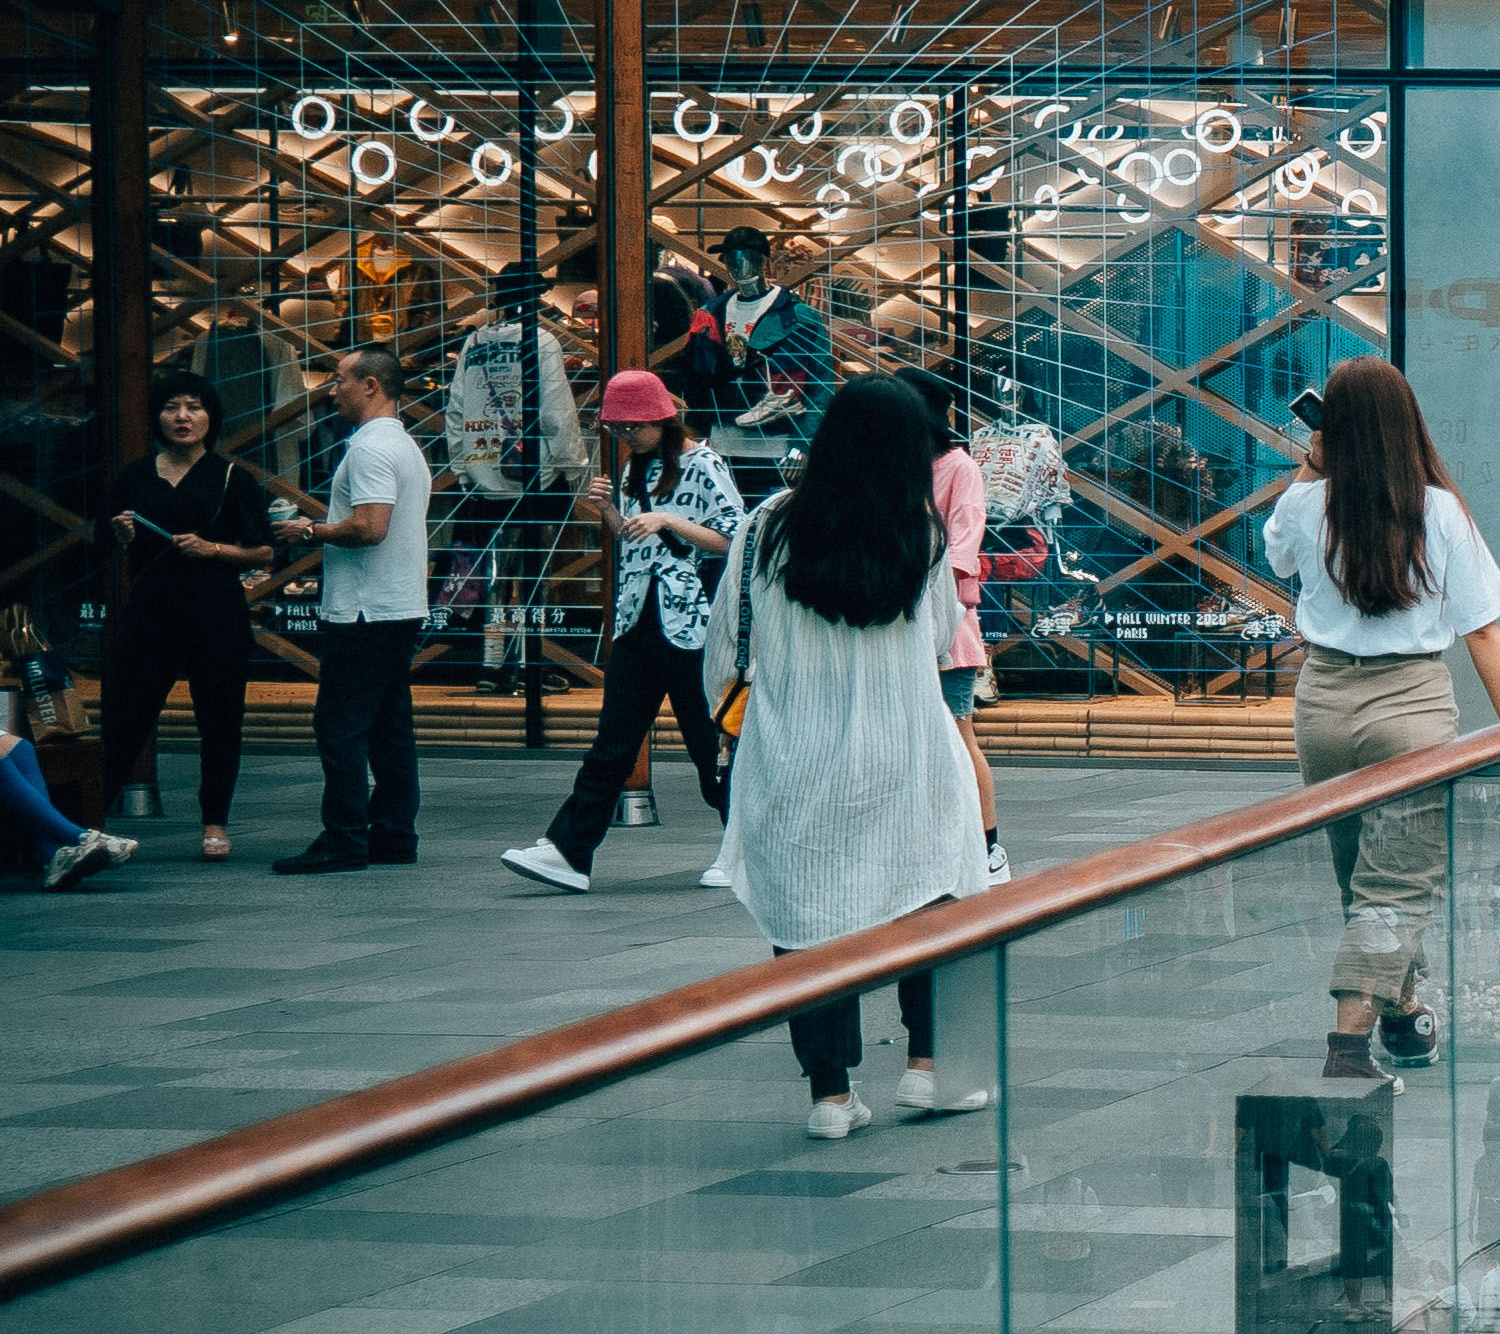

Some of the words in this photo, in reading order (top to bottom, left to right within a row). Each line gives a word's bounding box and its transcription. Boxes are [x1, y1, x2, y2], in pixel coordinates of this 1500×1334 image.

[490, 608, 566, 625] 最高得分
[1116, 613, 1141, 625] FALL
[1145, 613, 1191, 625] WINTER
[1196, 613, 1227, 626] 2020
[1116, 627, 1148, 640] PARIS
[26, 660, 57, 724] HOLLISTER
